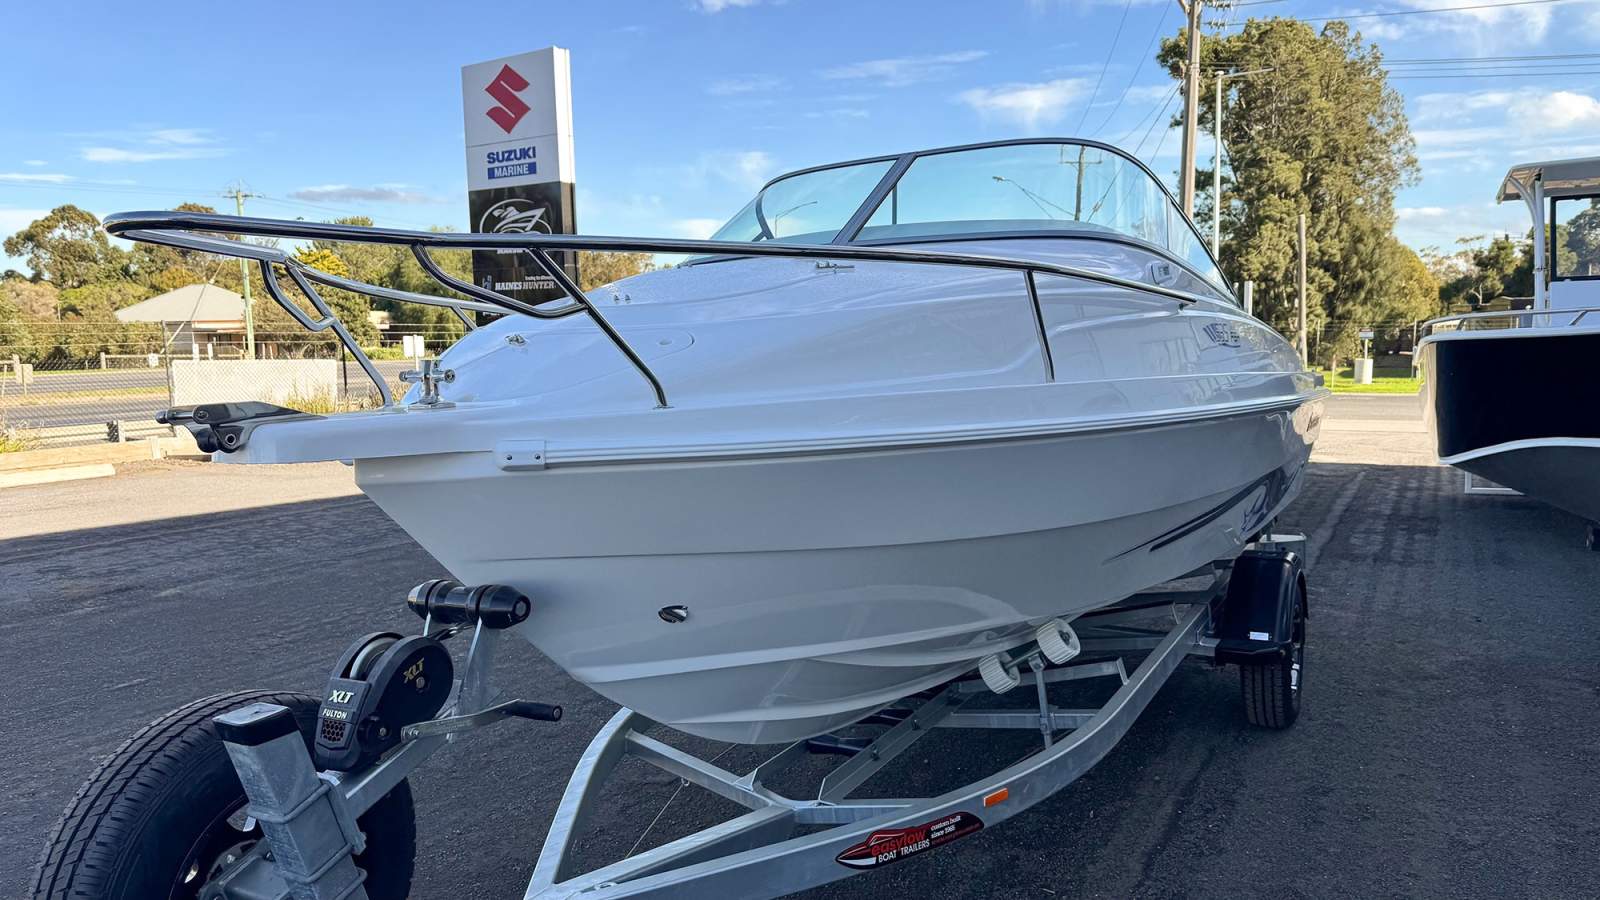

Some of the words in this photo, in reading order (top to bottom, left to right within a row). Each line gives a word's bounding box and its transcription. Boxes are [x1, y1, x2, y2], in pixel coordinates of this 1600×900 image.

[487, 146, 536, 164] SUZUKI
[494, 163, 529, 177] MARINE
[495, 281, 522, 291] HAINES
[522, 280, 555, 290] HUNTER
[403, 657, 424, 684] XLT
[329, 689, 354, 704] XLT
[322, 708, 347, 719] FULTON
[878, 850, 897, 863] BOAT
[901, 838, 930, 856] TRAILERS
